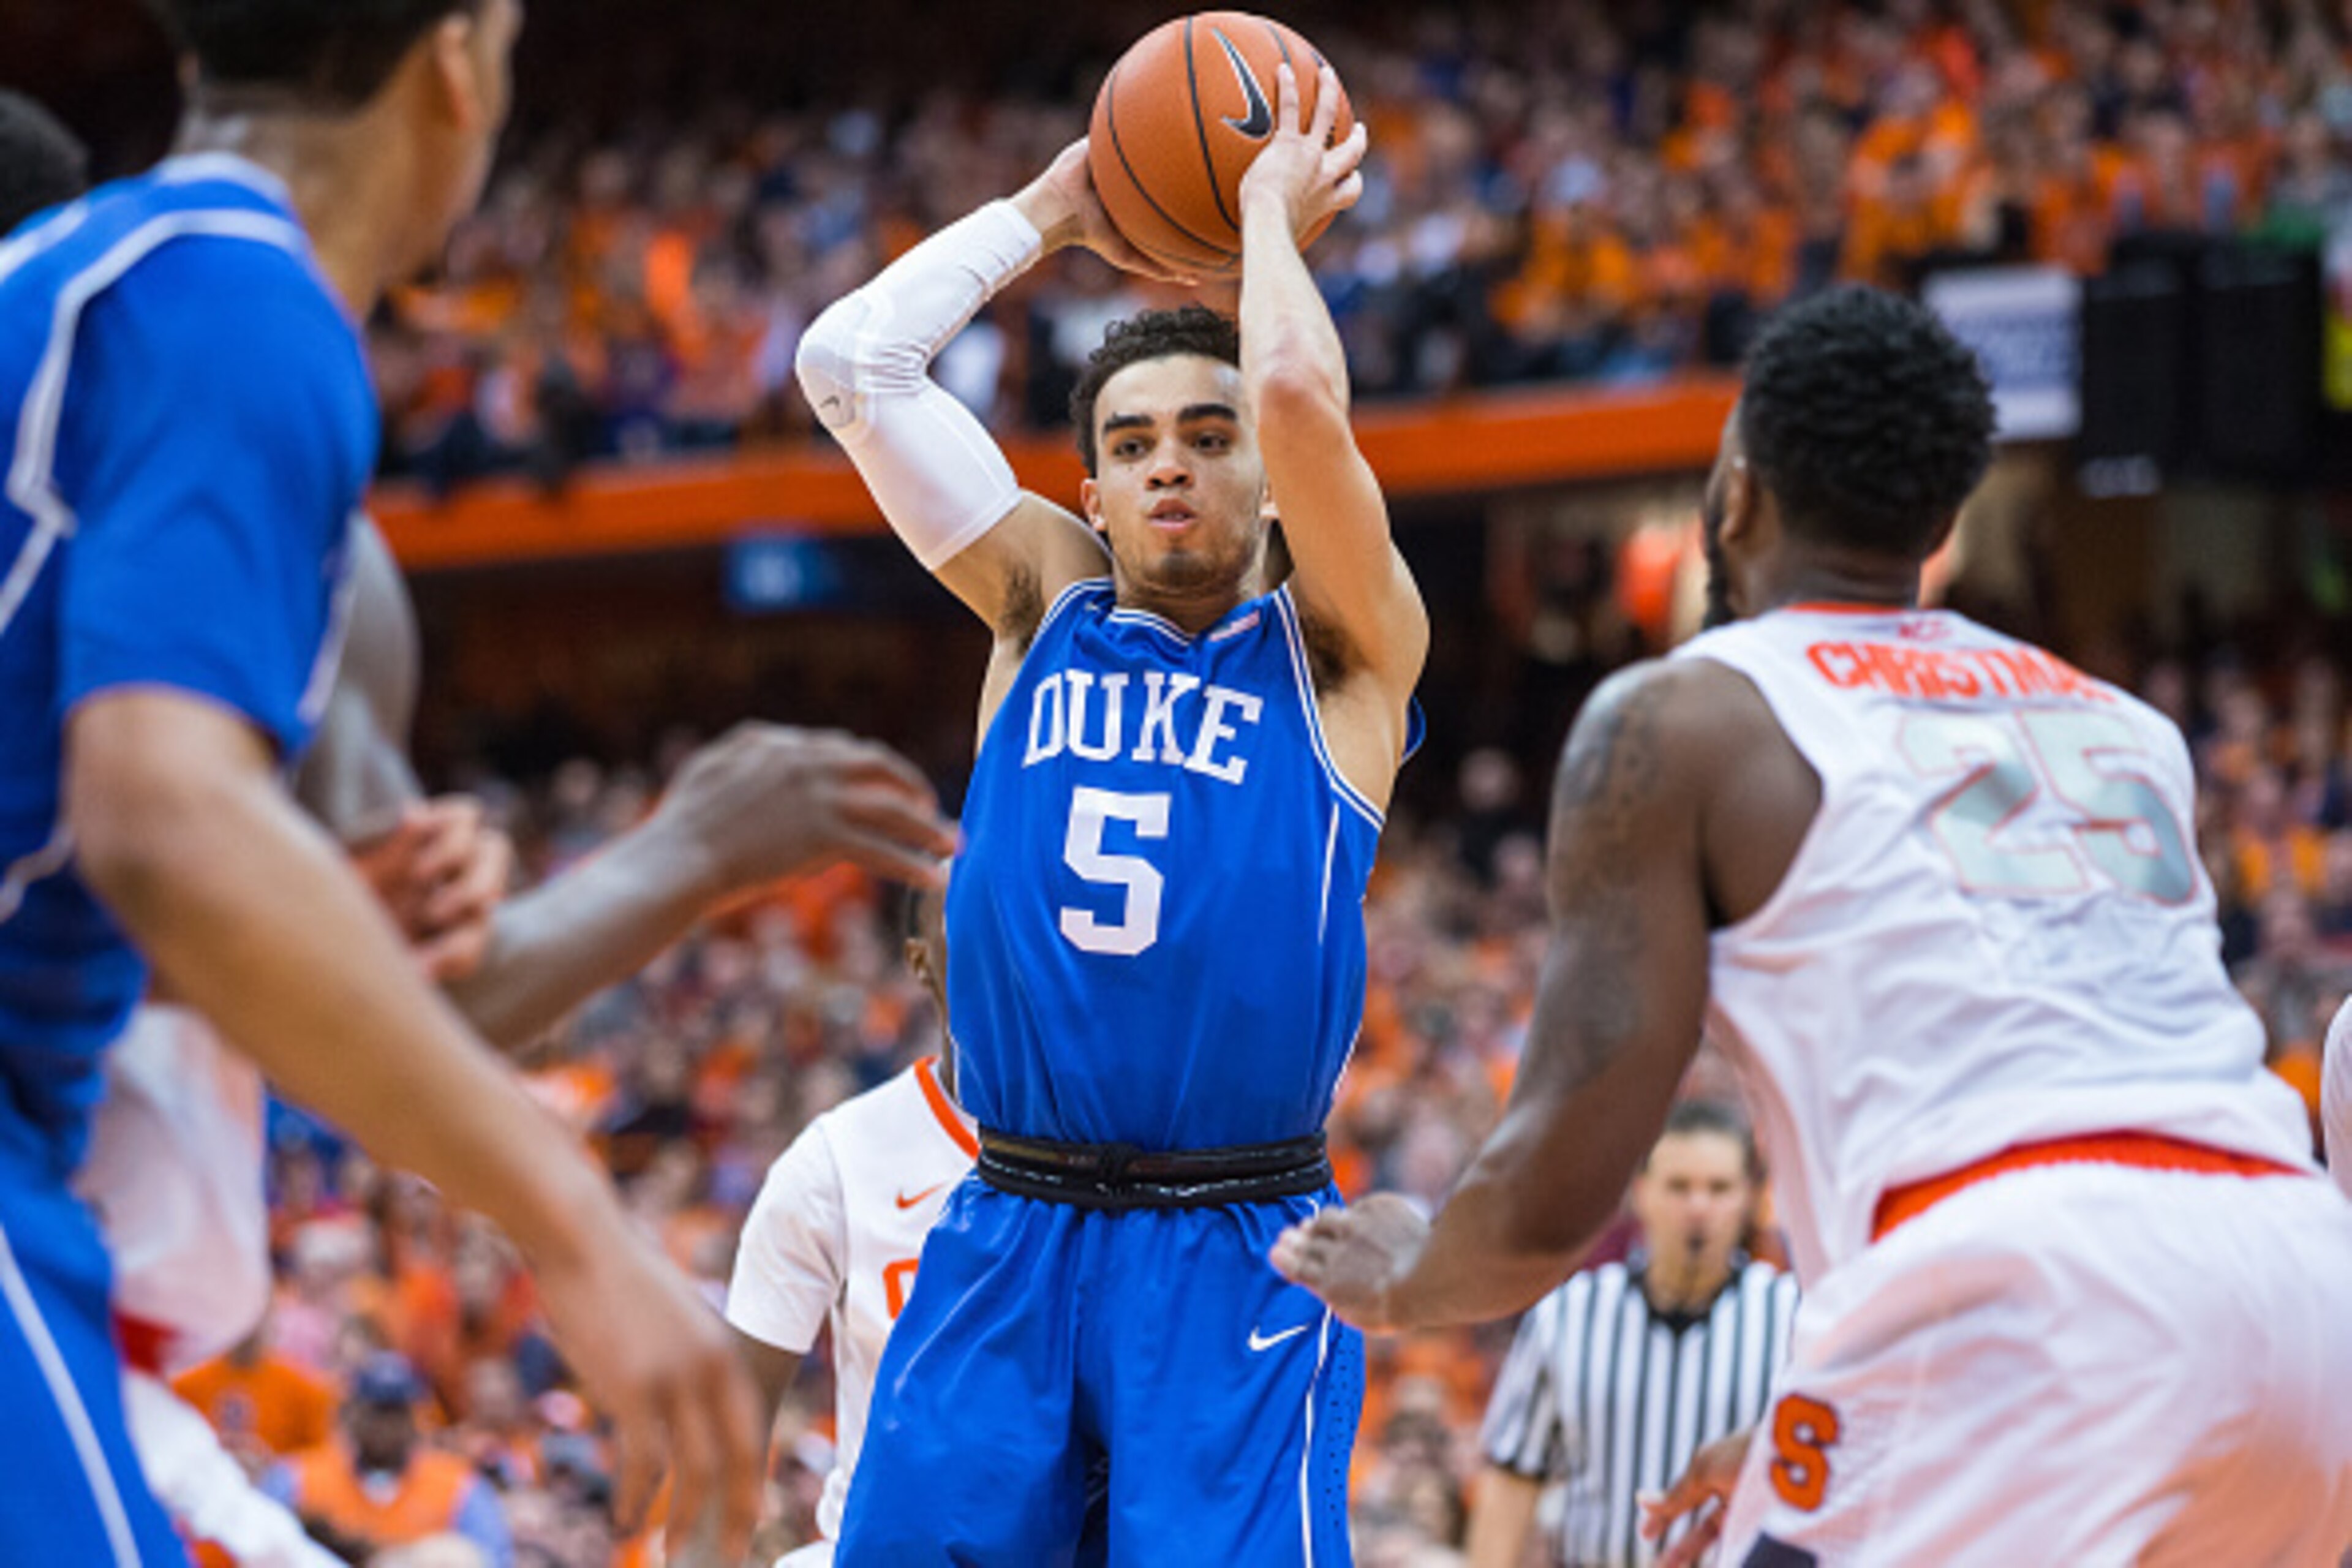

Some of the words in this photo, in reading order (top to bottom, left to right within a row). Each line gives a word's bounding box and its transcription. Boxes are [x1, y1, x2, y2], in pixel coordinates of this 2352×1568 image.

[1022, 669, 1264, 785] DUKE
[1806, 641, 2117, 703] CHRISTMA
[1896, 708, 2199, 908] 25
[1060, 785, 1171, 957] 5
[1769, 1392, 1843, 1513] S
